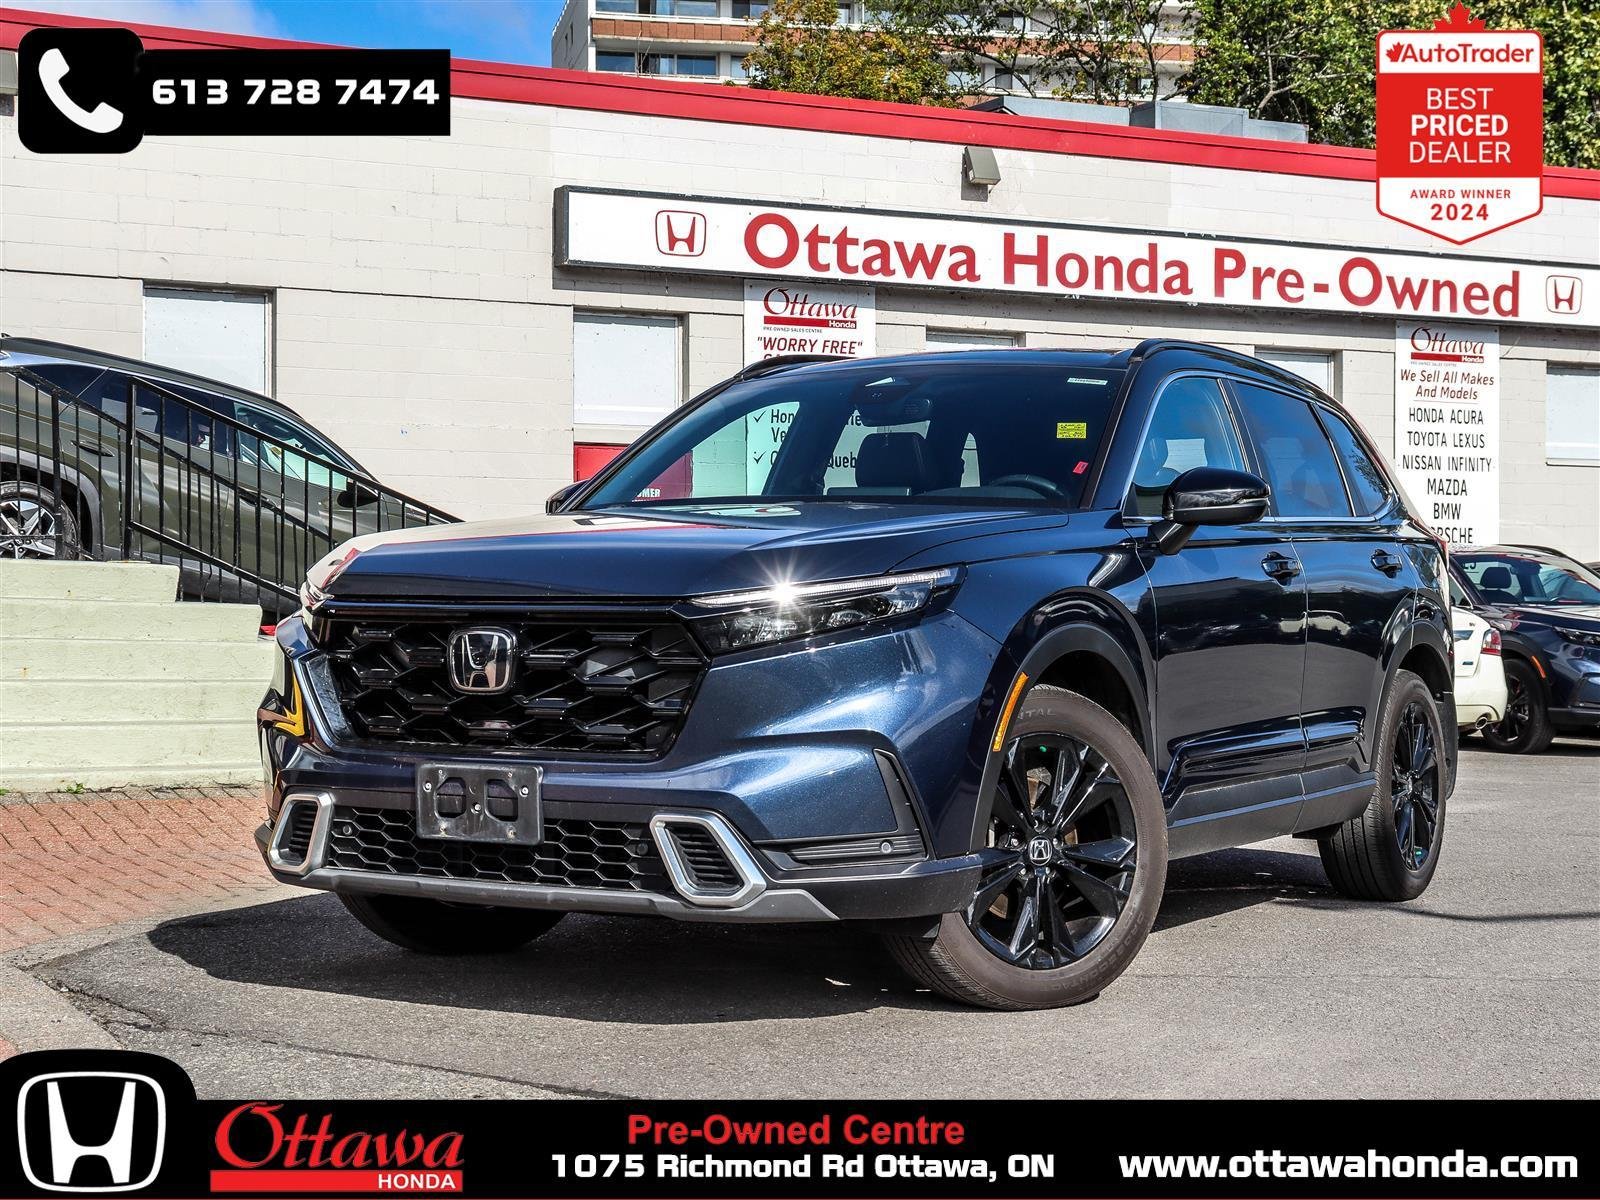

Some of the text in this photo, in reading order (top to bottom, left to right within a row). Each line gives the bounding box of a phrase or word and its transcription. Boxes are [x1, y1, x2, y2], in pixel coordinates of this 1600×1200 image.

[744, 213, 1520, 317] Ottawa Honda Pre-Owned
[763, 287, 858, 318] Ottawa
[828, 319, 856, 328] Honda
[757, 337, 863, 355] "WORRY FREE"
[1411, 327, 1484, 354] Ottawa
[1400, 369, 1495, 386] We Sell All Makes
[1415, 385, 1479, 400] And Models
[1408, 407, 1484, 425] HONDA ACURA
[1407, 431, 1485, 448] TOYOTA LEXUS
[1402, 454, 1492, 472] NISSAN INFINITY
[1427, 478, 1468, 496] MAZDA
[1433, 503, 1462, 520] BMW
